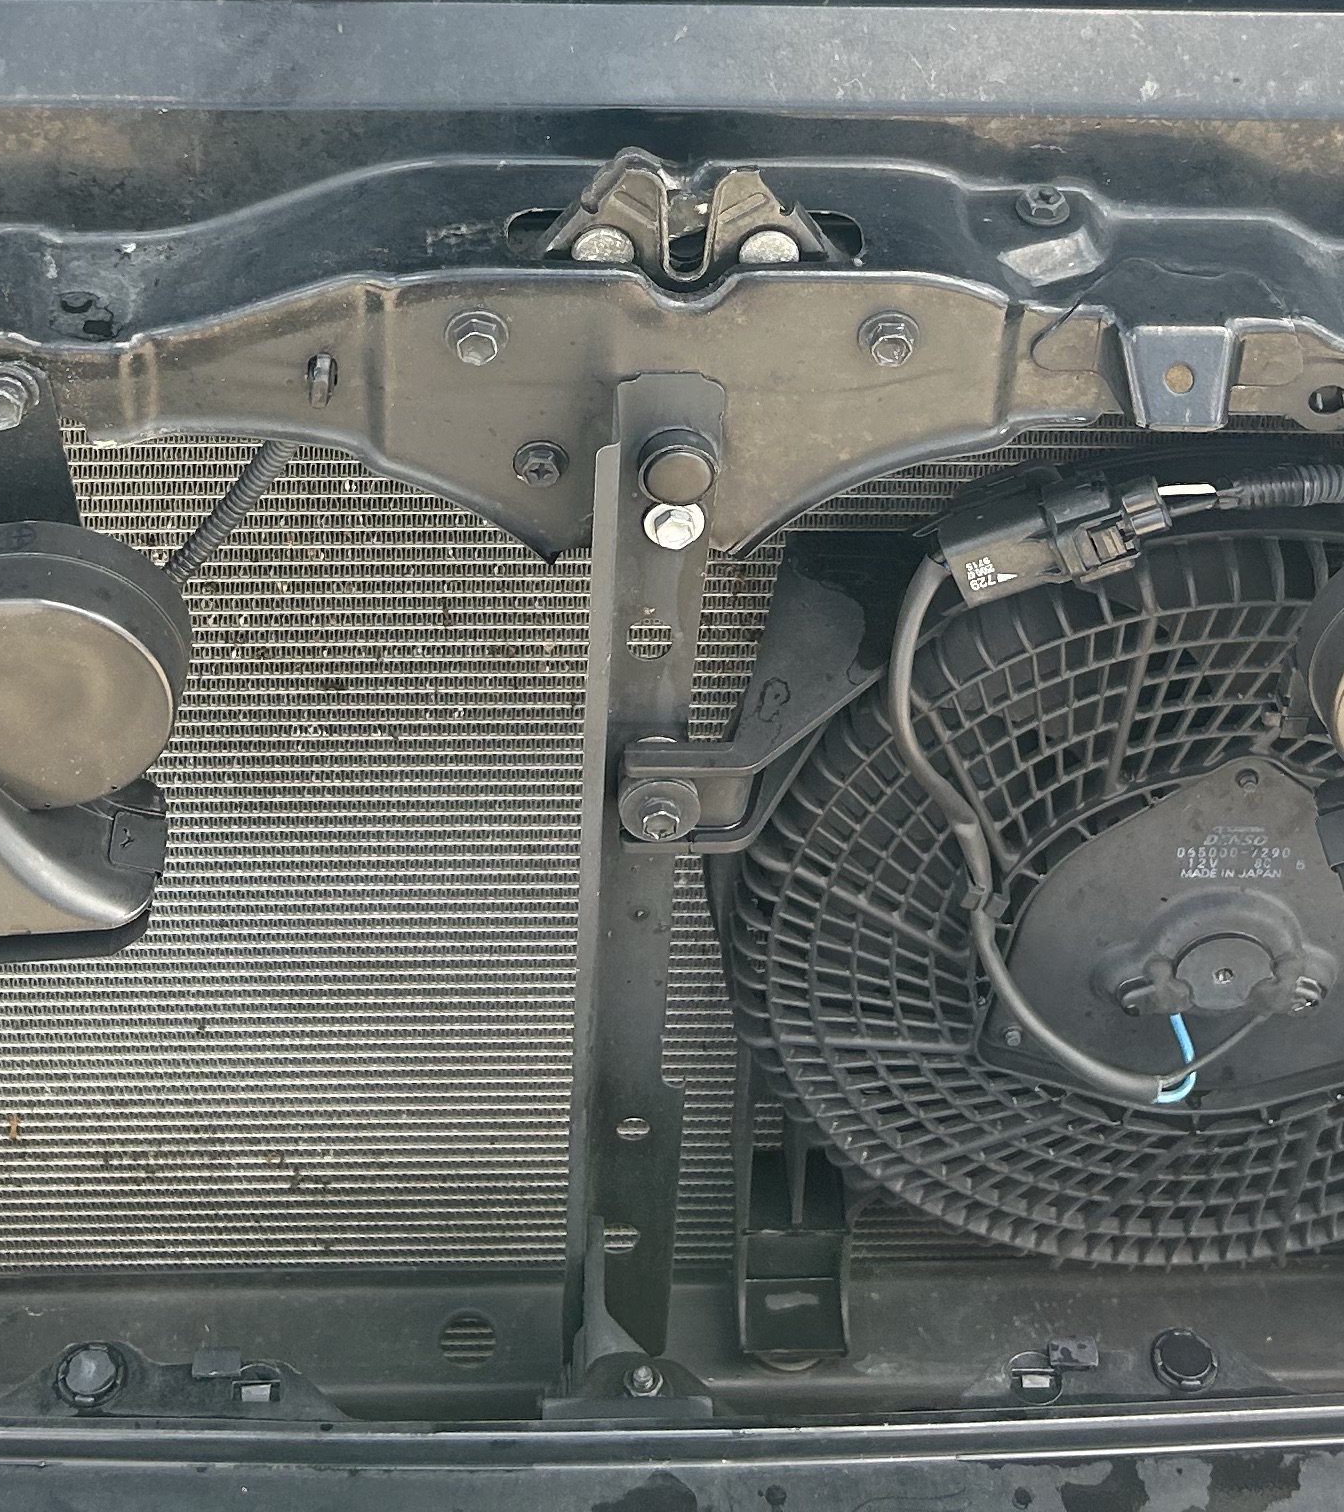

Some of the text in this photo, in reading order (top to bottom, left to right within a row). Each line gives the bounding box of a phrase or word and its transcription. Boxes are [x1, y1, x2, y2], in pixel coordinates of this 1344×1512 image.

[969, 573, 997, 591] 729
[1204, 834, 1269, 846] DENSO
[1188, 858, 1218, 869] 12V
[1181, 869, 1282, 879] MADE IN JAPAN
